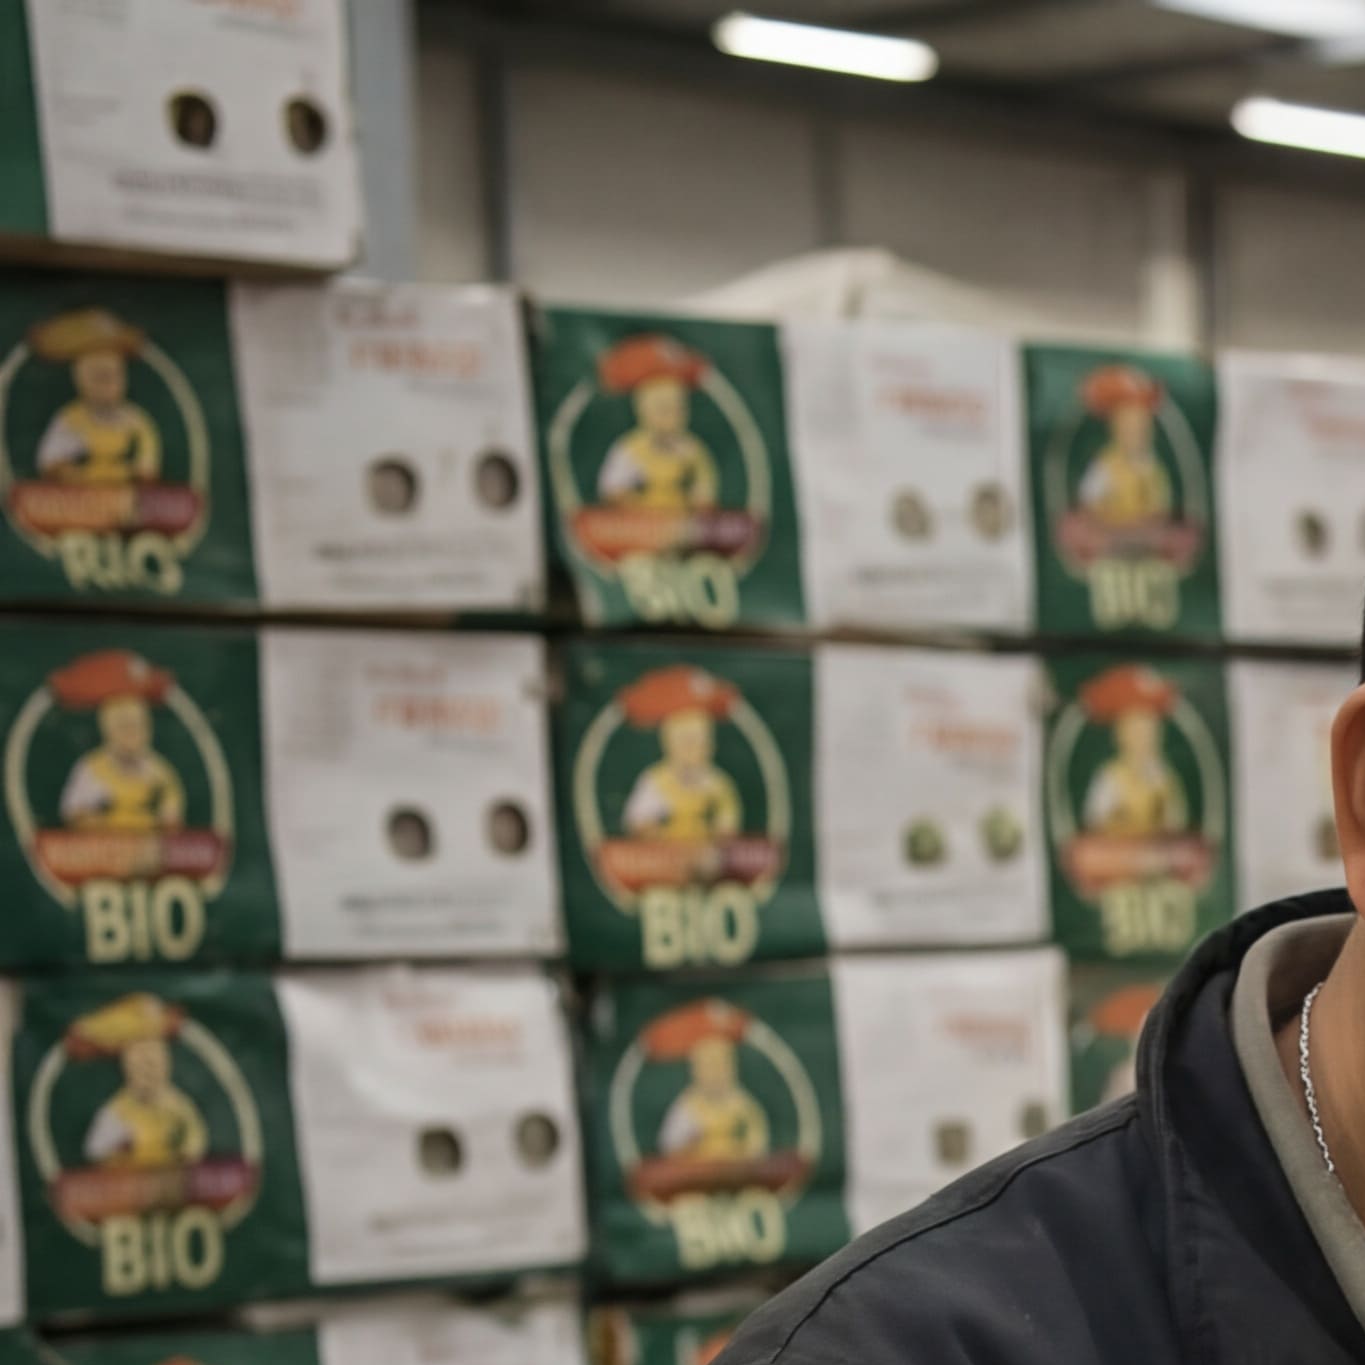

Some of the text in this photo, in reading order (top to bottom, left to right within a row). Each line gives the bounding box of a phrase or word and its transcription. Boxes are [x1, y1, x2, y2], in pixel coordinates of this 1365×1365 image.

[83, 878, 203, 962] BIO
[640, 883, 761, 970] BIO
[101, 1211, 223, 1295] BIO
